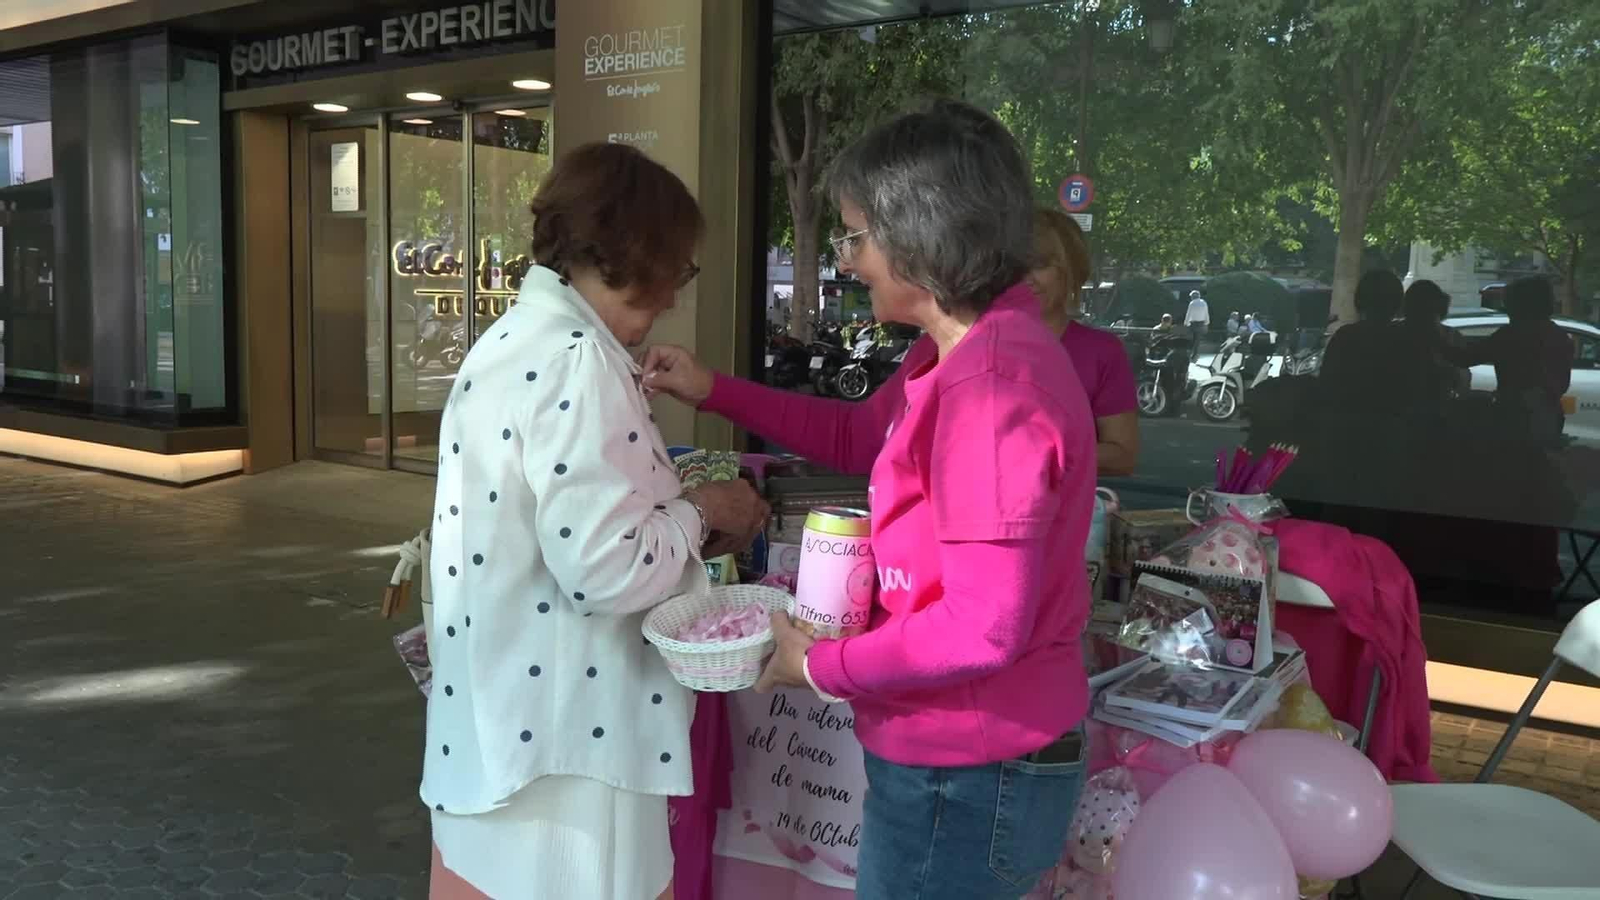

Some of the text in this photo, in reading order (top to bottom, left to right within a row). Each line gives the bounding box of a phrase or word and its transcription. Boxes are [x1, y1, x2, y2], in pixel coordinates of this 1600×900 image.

[230, 25, 360, 76] GOURMET
[584, 24, 686, 58] GOURMET
[584, 47, 686, 75] EXPERIENCE
[623, 131, 659, 141] PLANTA
[747, 726, 778, 753] del
[771, 764, 852, 804] de mama
